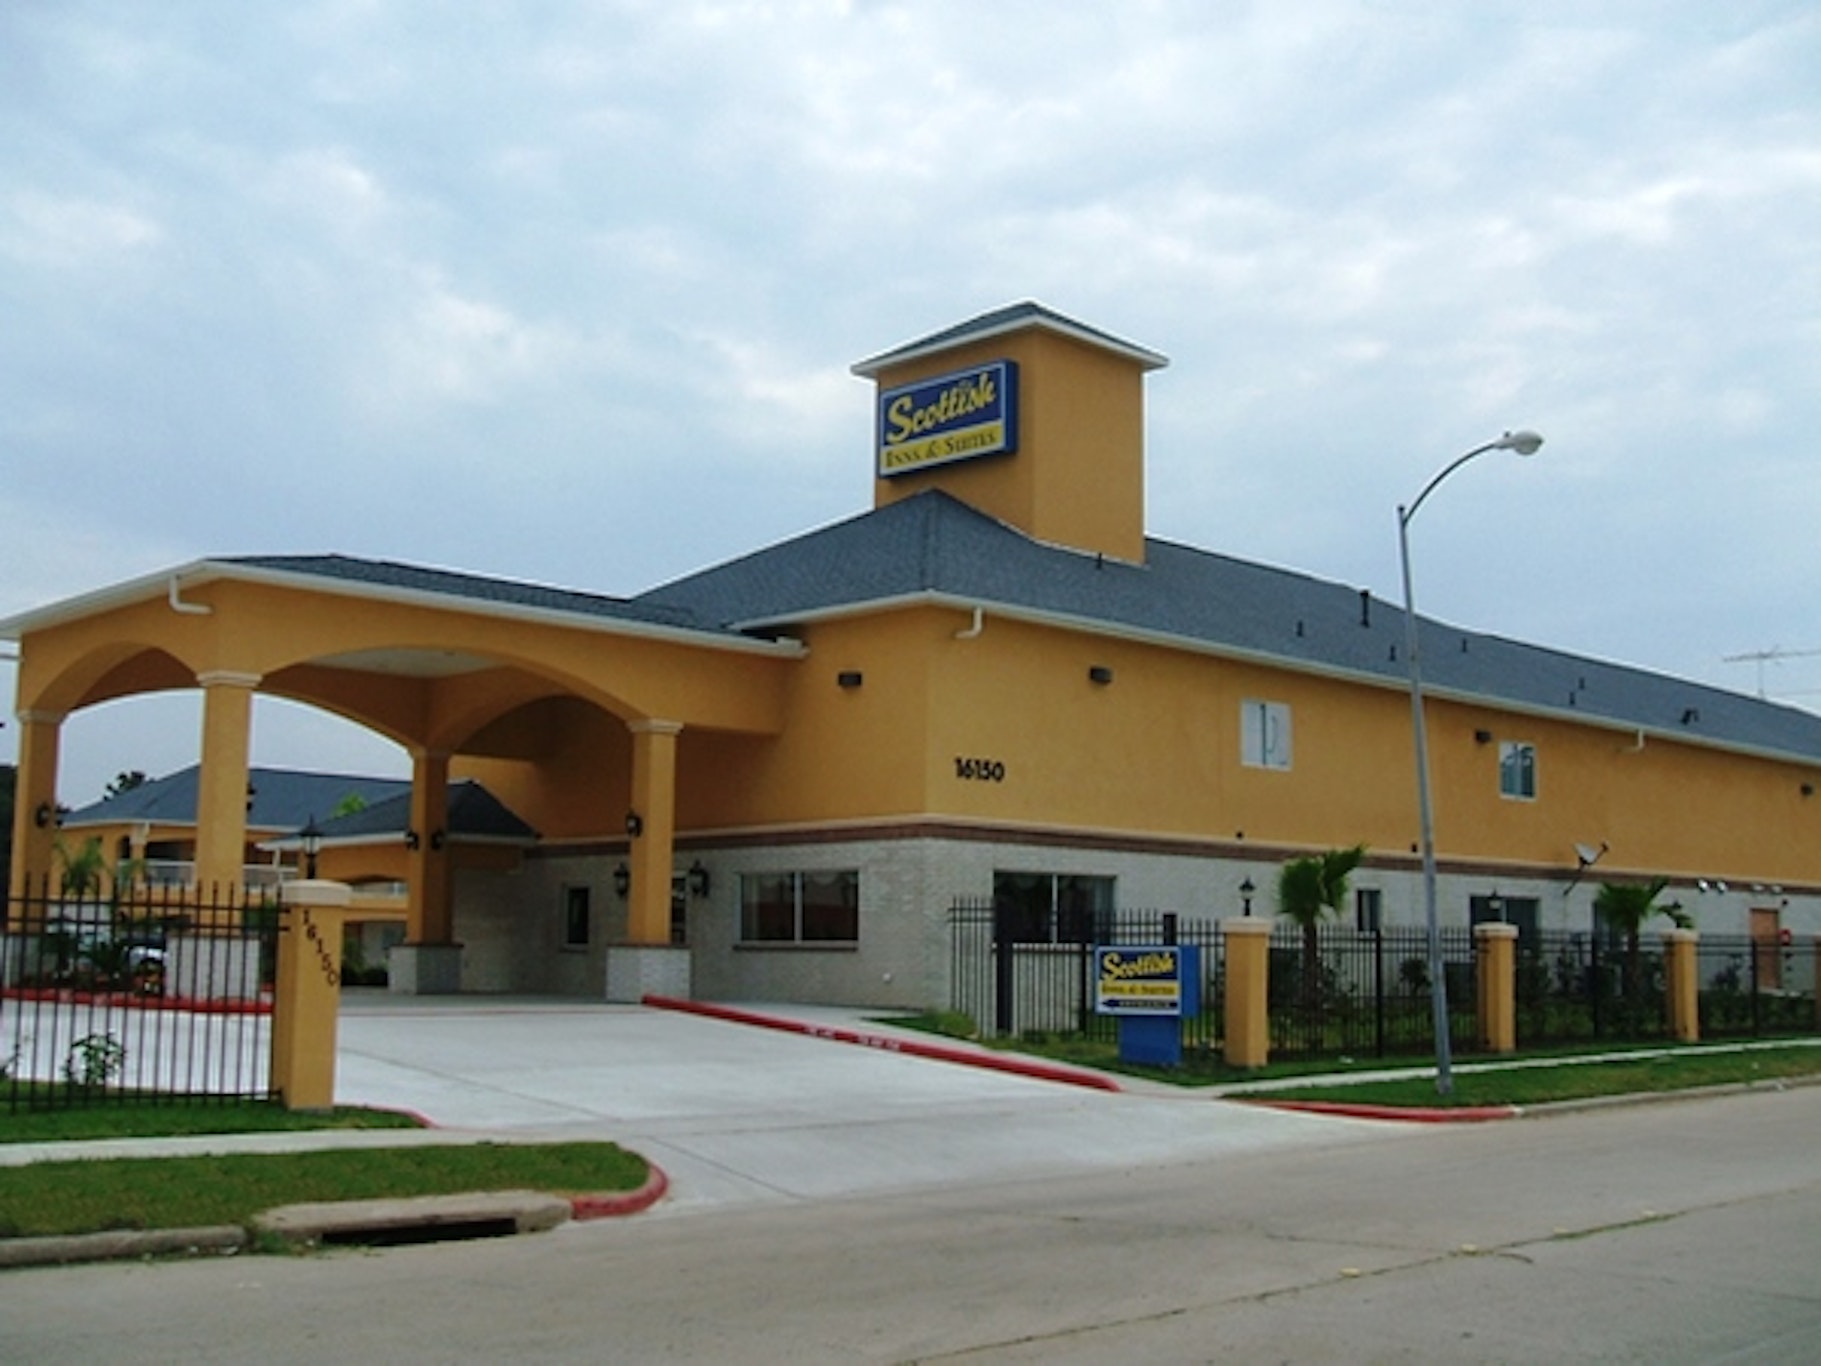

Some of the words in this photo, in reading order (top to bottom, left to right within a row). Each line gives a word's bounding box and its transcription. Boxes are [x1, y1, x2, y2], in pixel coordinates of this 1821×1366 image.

[886, 372, 997, 445] Scottish
[925, 440, 938, 459] &
[955, 757, 1005, 783] 16150
[303, 907, 338, 987] 16150
[1101, 951, 1175, 983] Scottish
